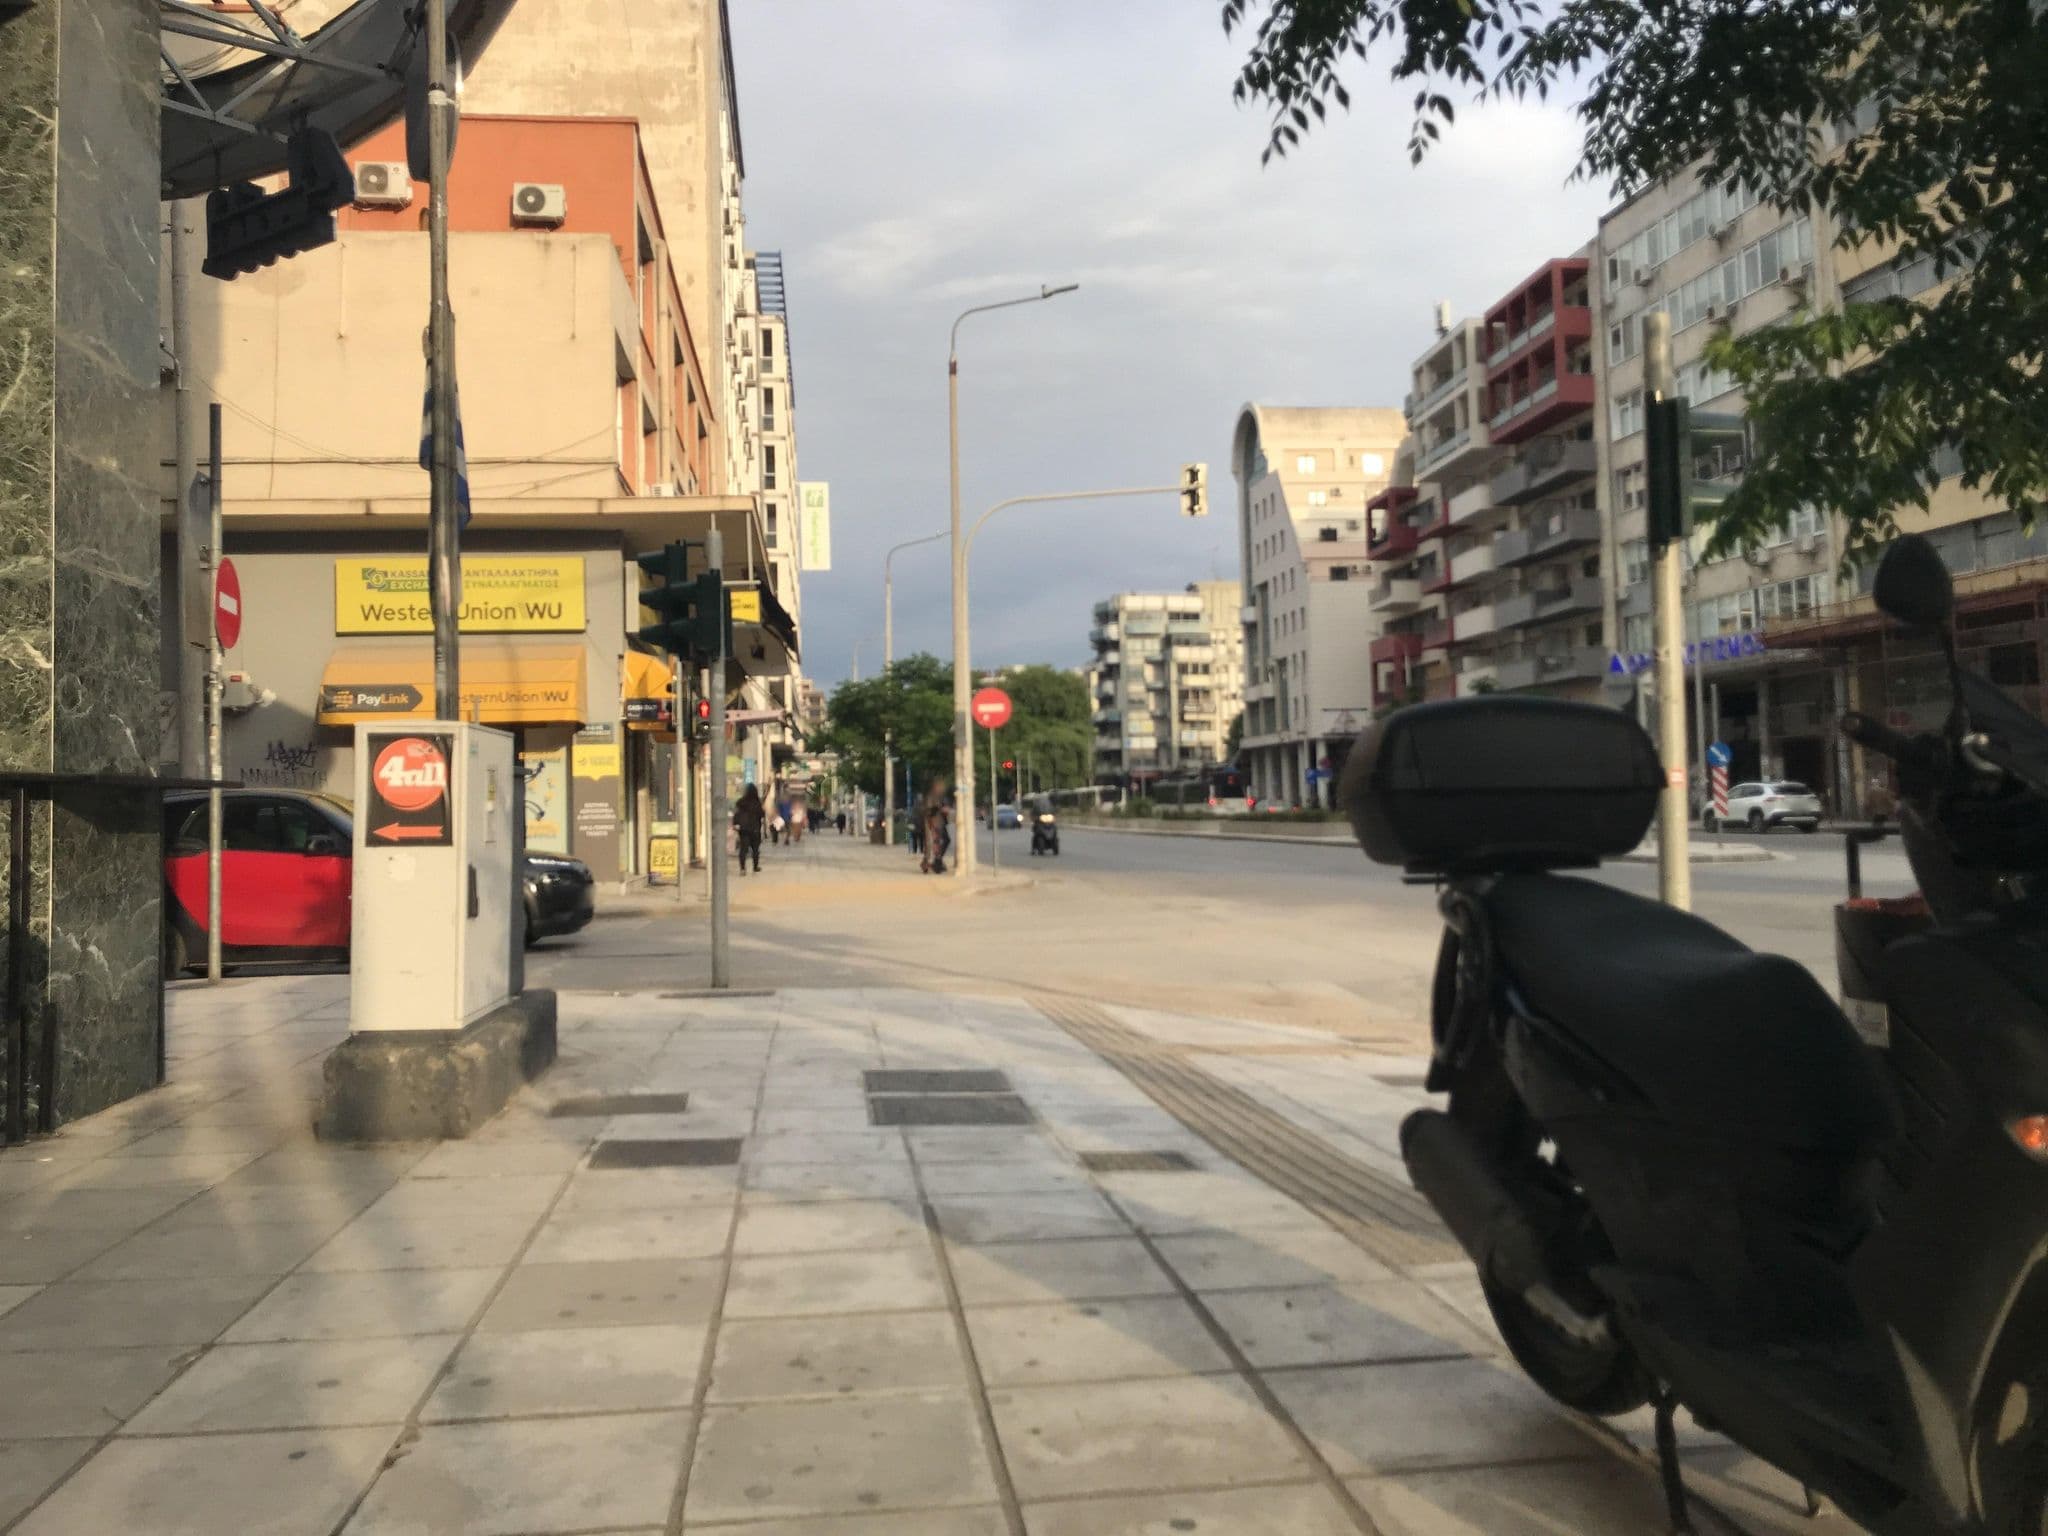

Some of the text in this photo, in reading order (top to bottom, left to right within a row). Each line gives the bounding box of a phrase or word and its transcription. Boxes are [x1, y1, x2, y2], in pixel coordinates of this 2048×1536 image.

[390, 569, 426, 578] KASSA
[390, 581, 429, 590] EXCHA
[360, 601, 562, 621] Weste Union WU
[357, 693, 409, 706] PayLink
[379, 755, 446, 787] 4all
